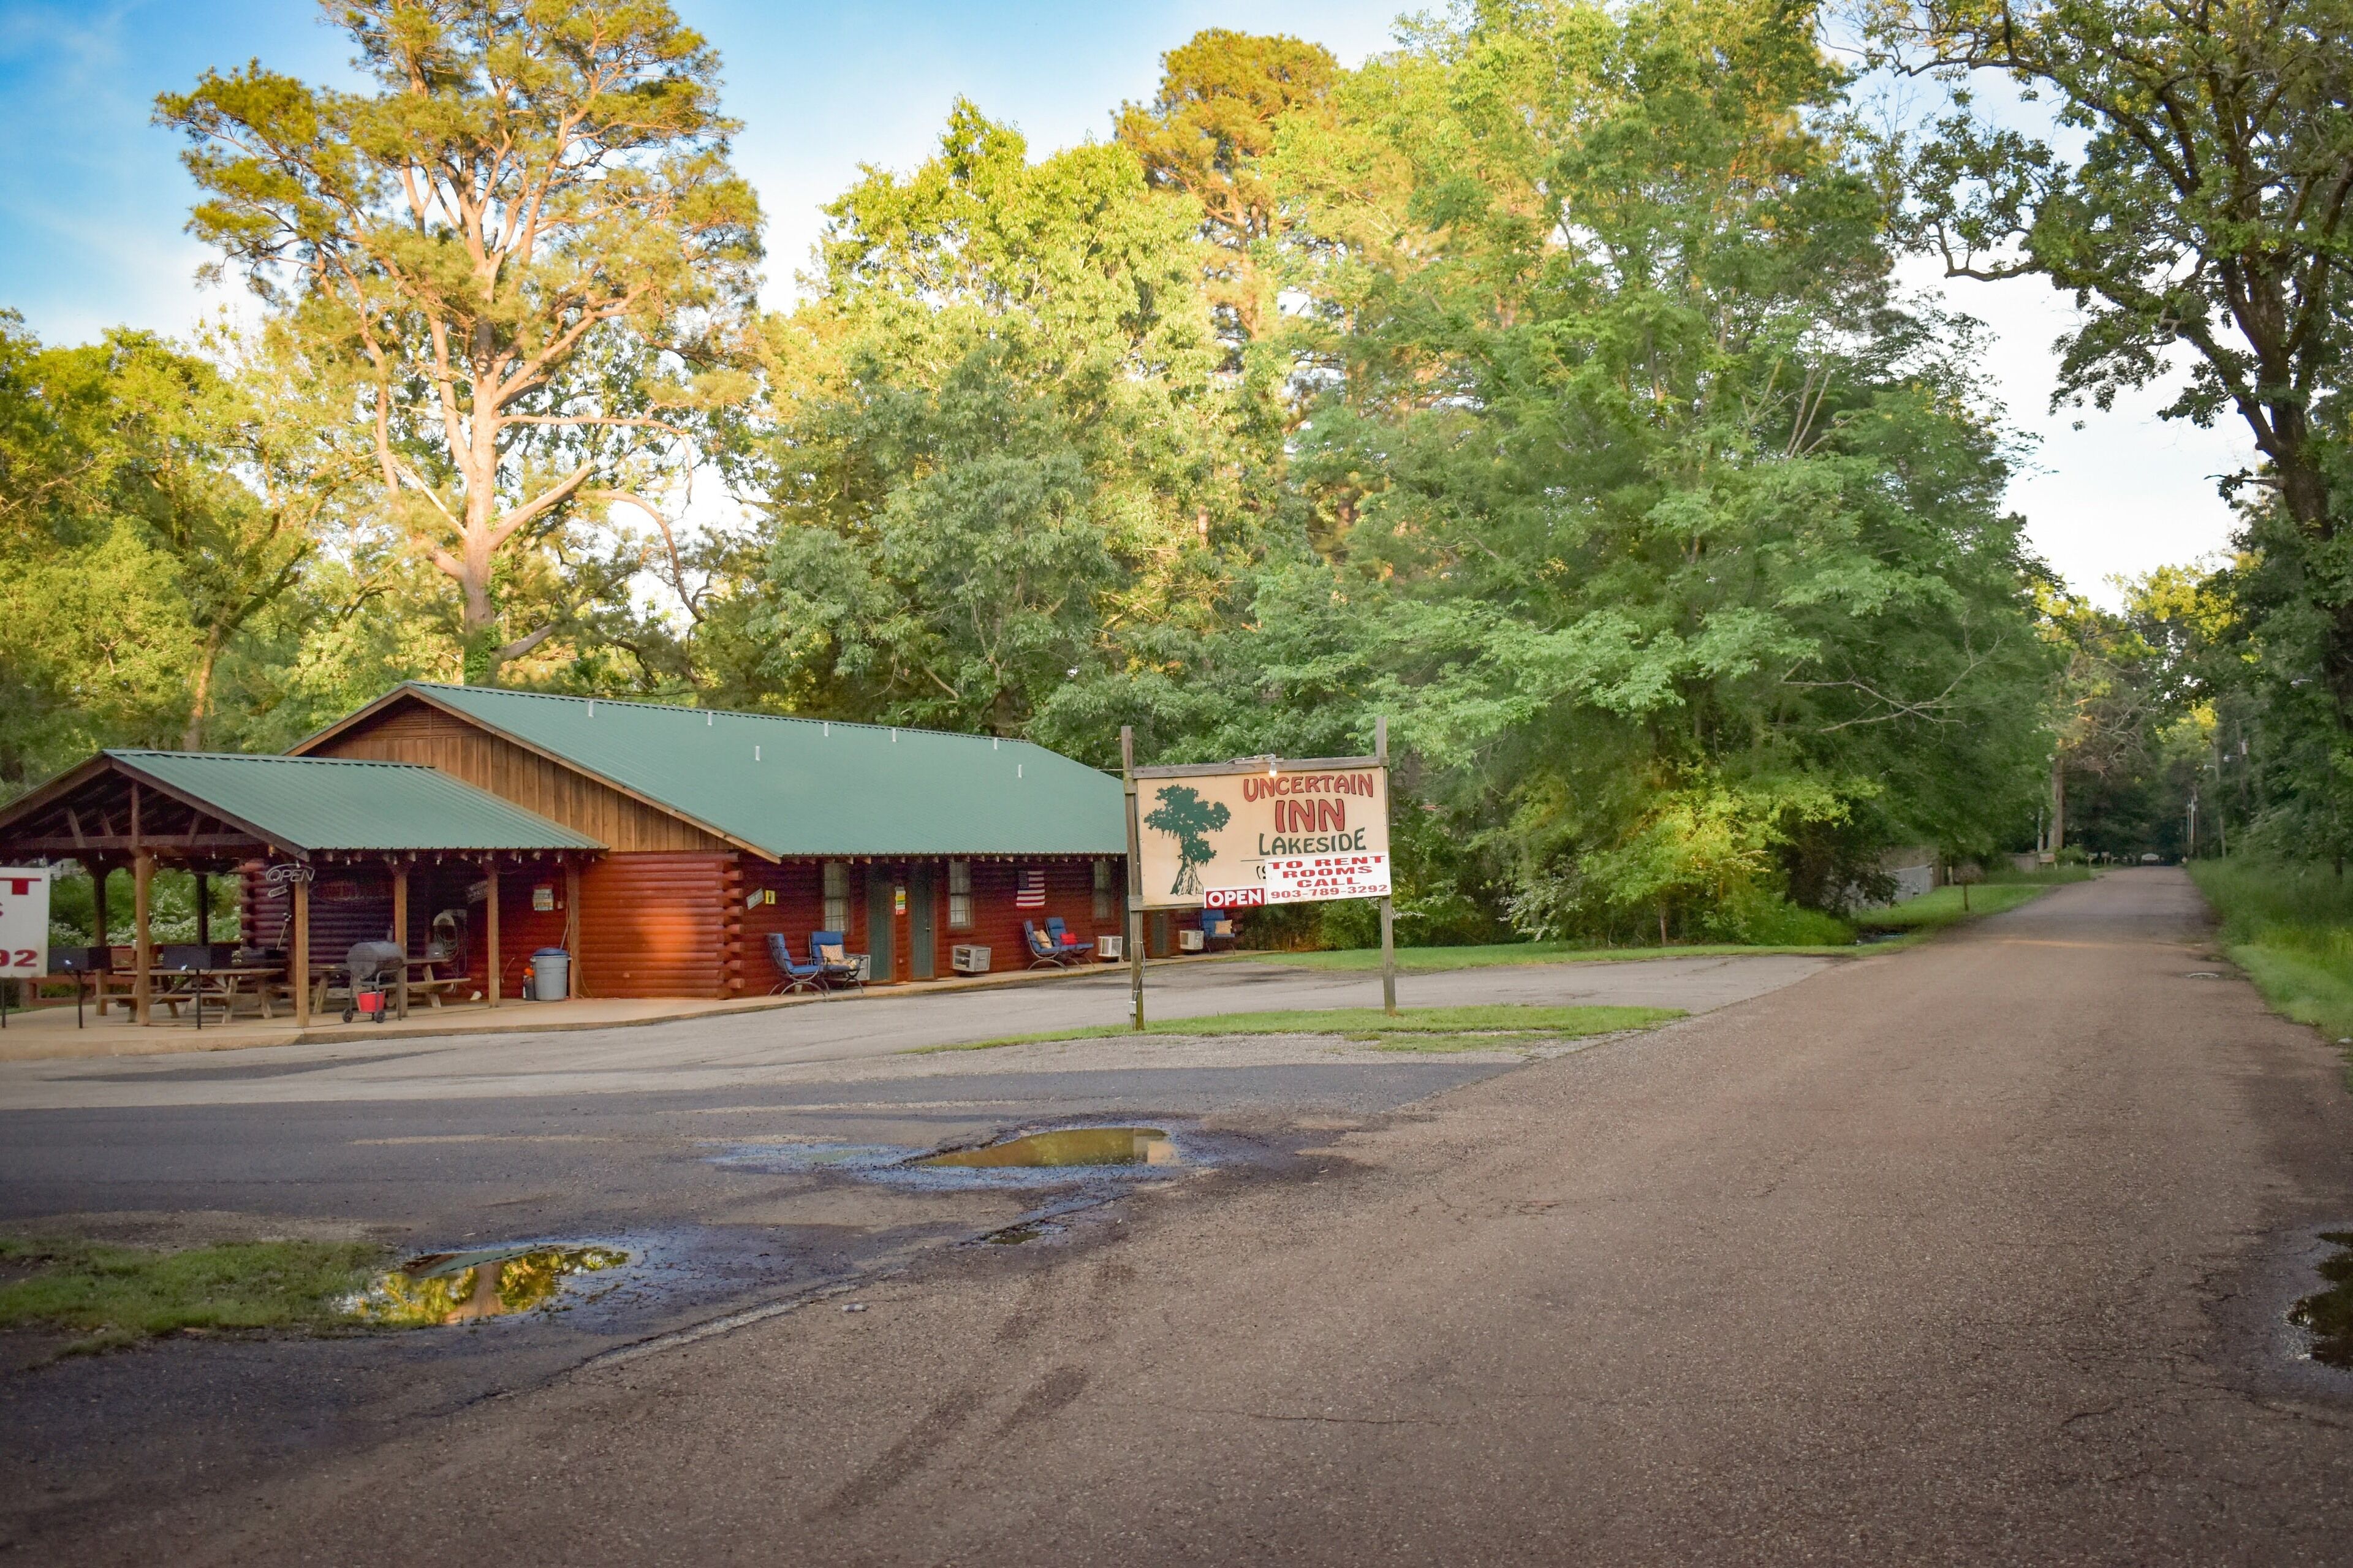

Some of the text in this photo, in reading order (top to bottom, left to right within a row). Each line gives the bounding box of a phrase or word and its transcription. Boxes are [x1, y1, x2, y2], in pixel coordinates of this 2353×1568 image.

[1243, 774, 1374, 803] UNCERTAIN
[1275, 798, 1346, 833] INN
[1259, 827, 1367, 856] LAKESIDE
[1268, 855, 1386, 870] TO RENT
[268, 869, 316, 882] OPEN
[1283, 866, 1373, 879] ROOMS
[1297, 877, 1360, 888] CALL
[1208, 889, 1262, 907] OPEN
[1270, 884, 1388, 899] 903-789-3292
